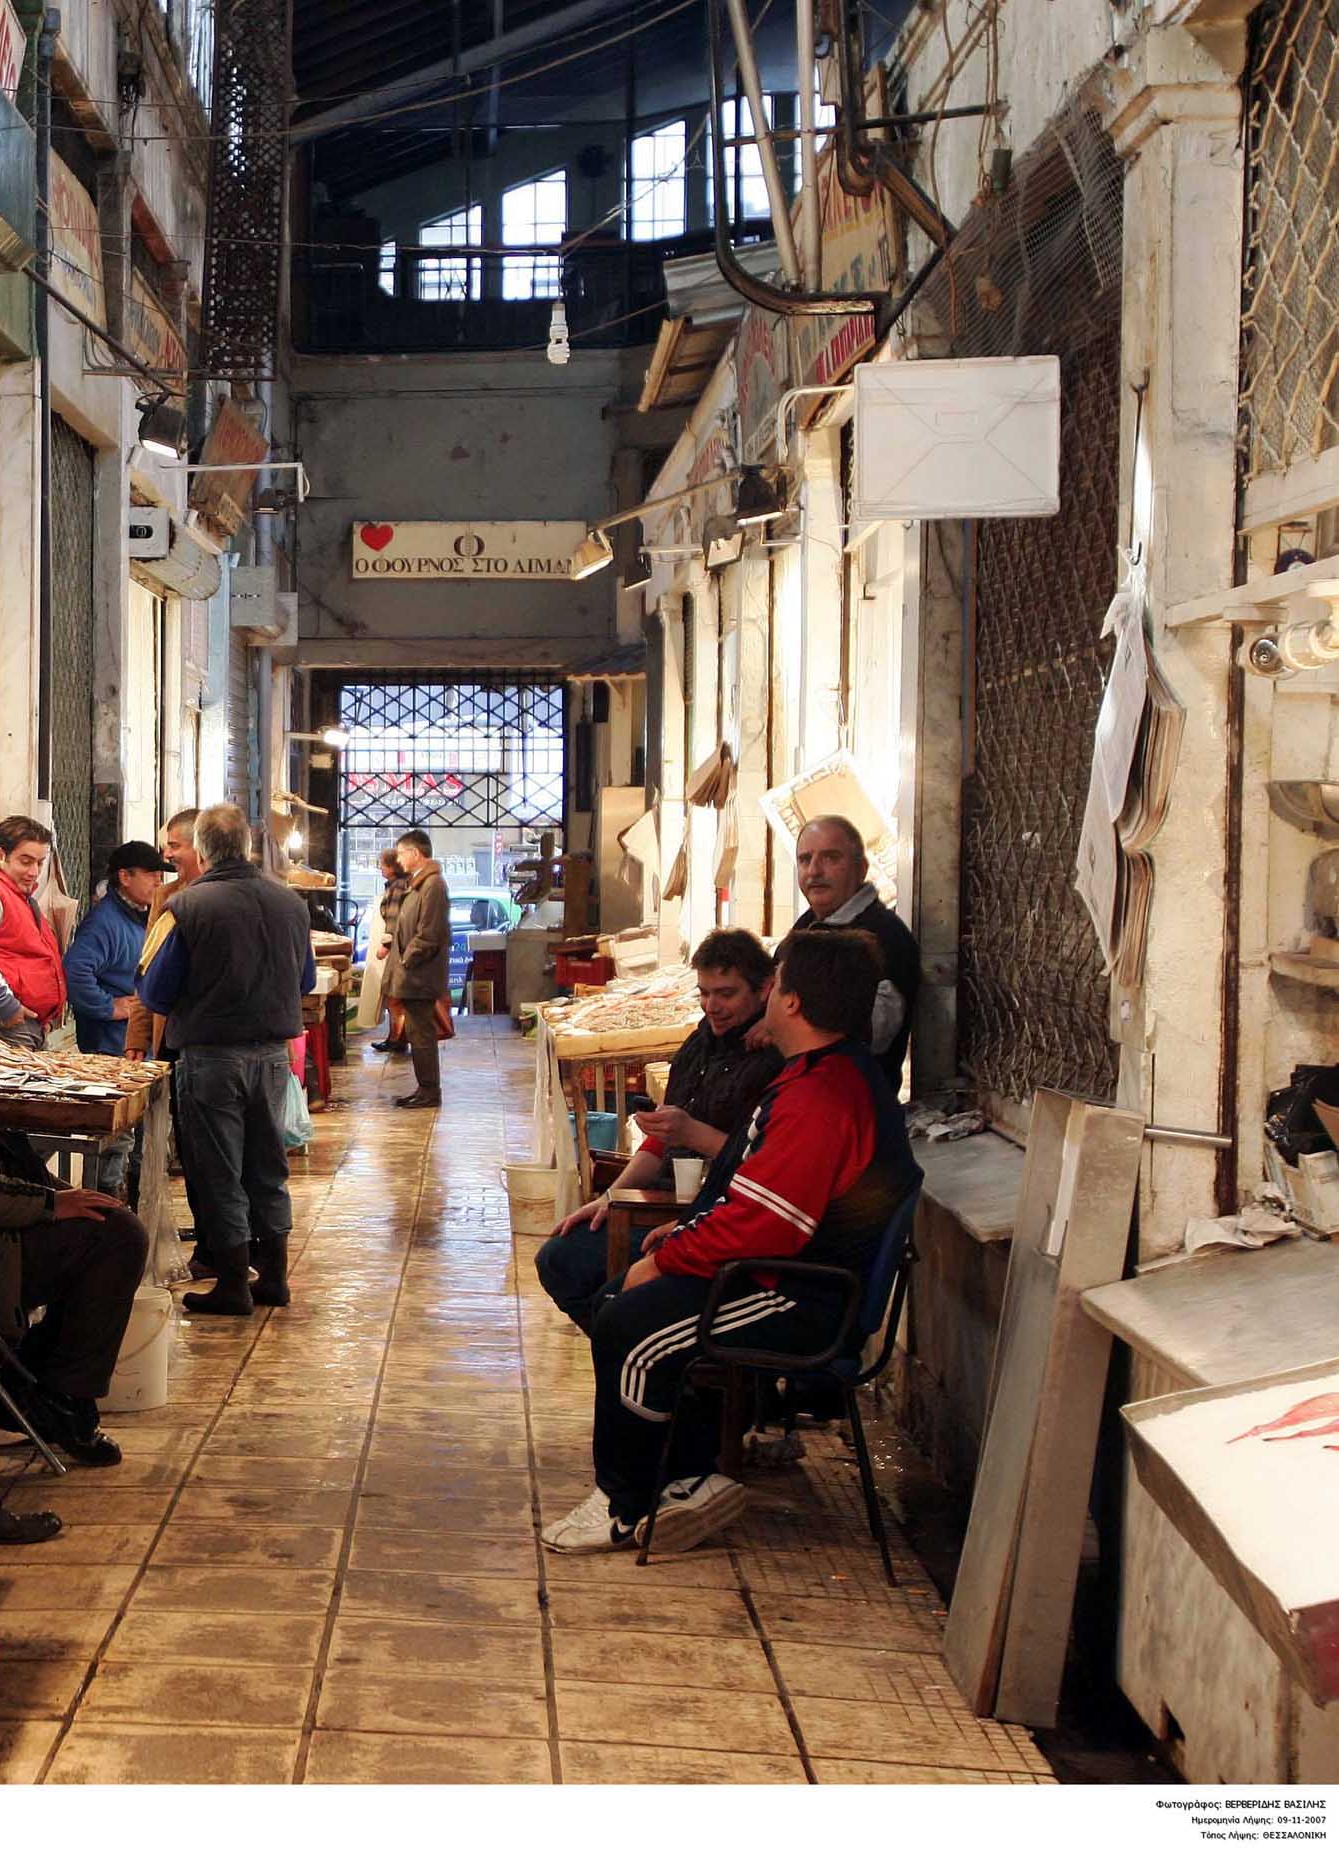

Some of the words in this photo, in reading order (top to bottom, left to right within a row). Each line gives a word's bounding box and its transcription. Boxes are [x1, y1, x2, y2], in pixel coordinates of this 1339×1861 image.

[355, 558, 369, 574] Ο
[372, 556, 464, 575] ΦΟΥΡΝΟΣ
[472, 557, 508, 574] ΣΤΟ
